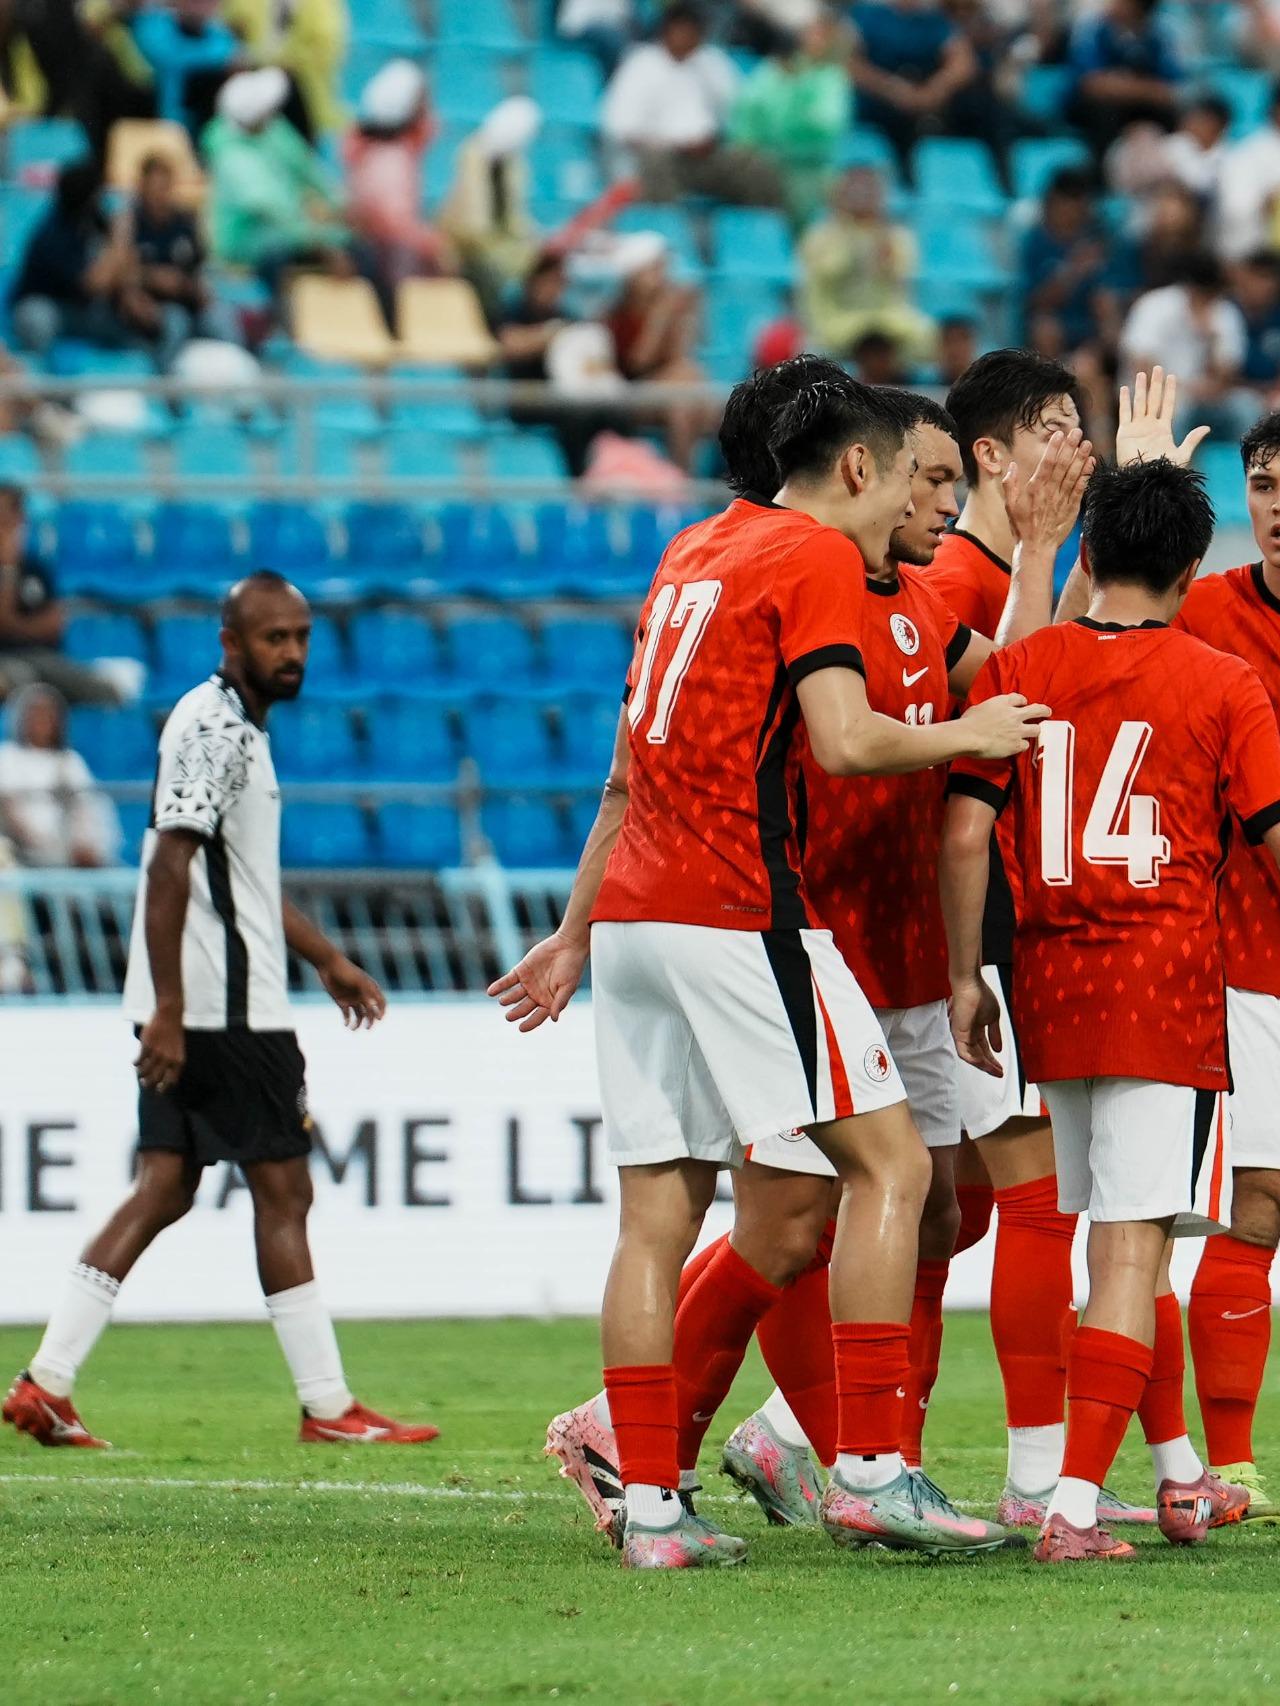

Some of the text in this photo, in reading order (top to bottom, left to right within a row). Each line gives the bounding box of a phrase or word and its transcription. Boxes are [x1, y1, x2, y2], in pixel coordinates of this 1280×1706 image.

[628, 579, 722, 744] 17
[1032, 720, 1171, 888] 14
[131, 1116, 453, 1207] ME
